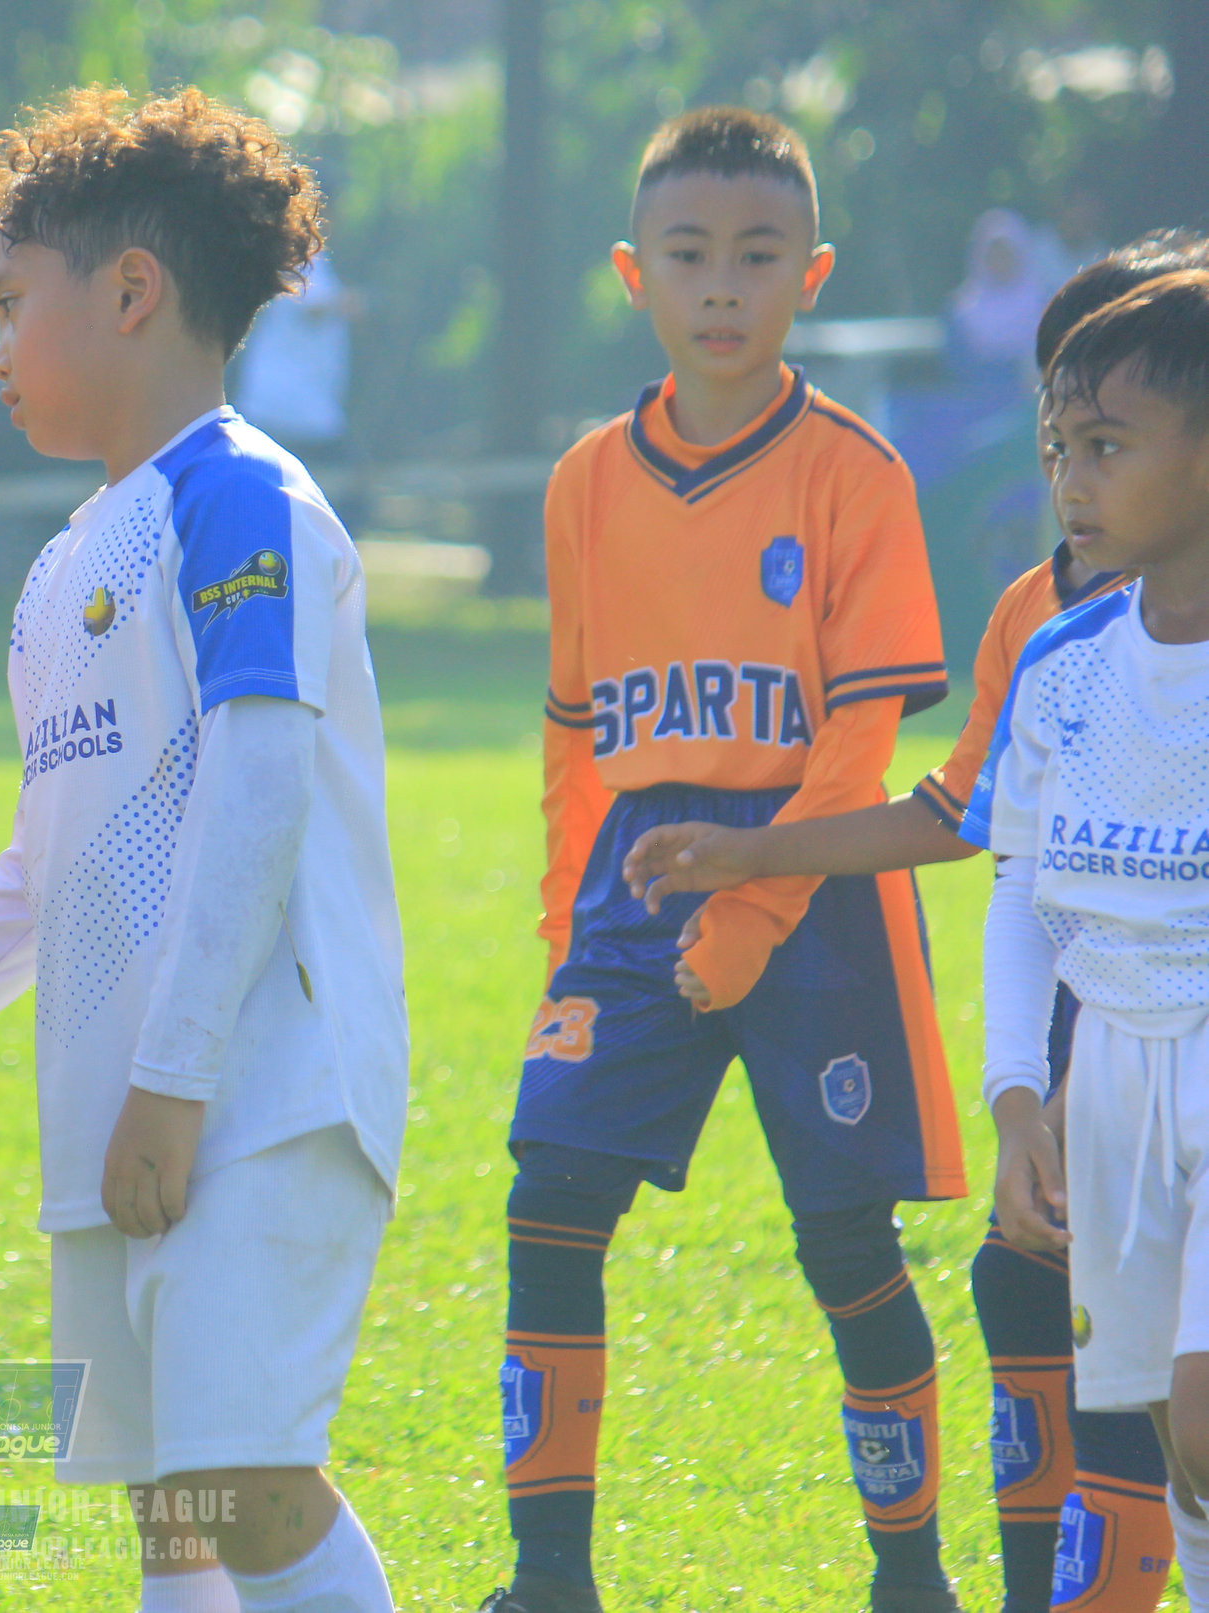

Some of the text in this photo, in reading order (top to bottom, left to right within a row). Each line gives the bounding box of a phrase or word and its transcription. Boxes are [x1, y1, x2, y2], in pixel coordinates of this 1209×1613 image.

[200, 575, 277, 604] BSS INTERNAL
[591, 659, 815, 762] SPARTA
[39, 731, 123, 774] SCHOOLS
